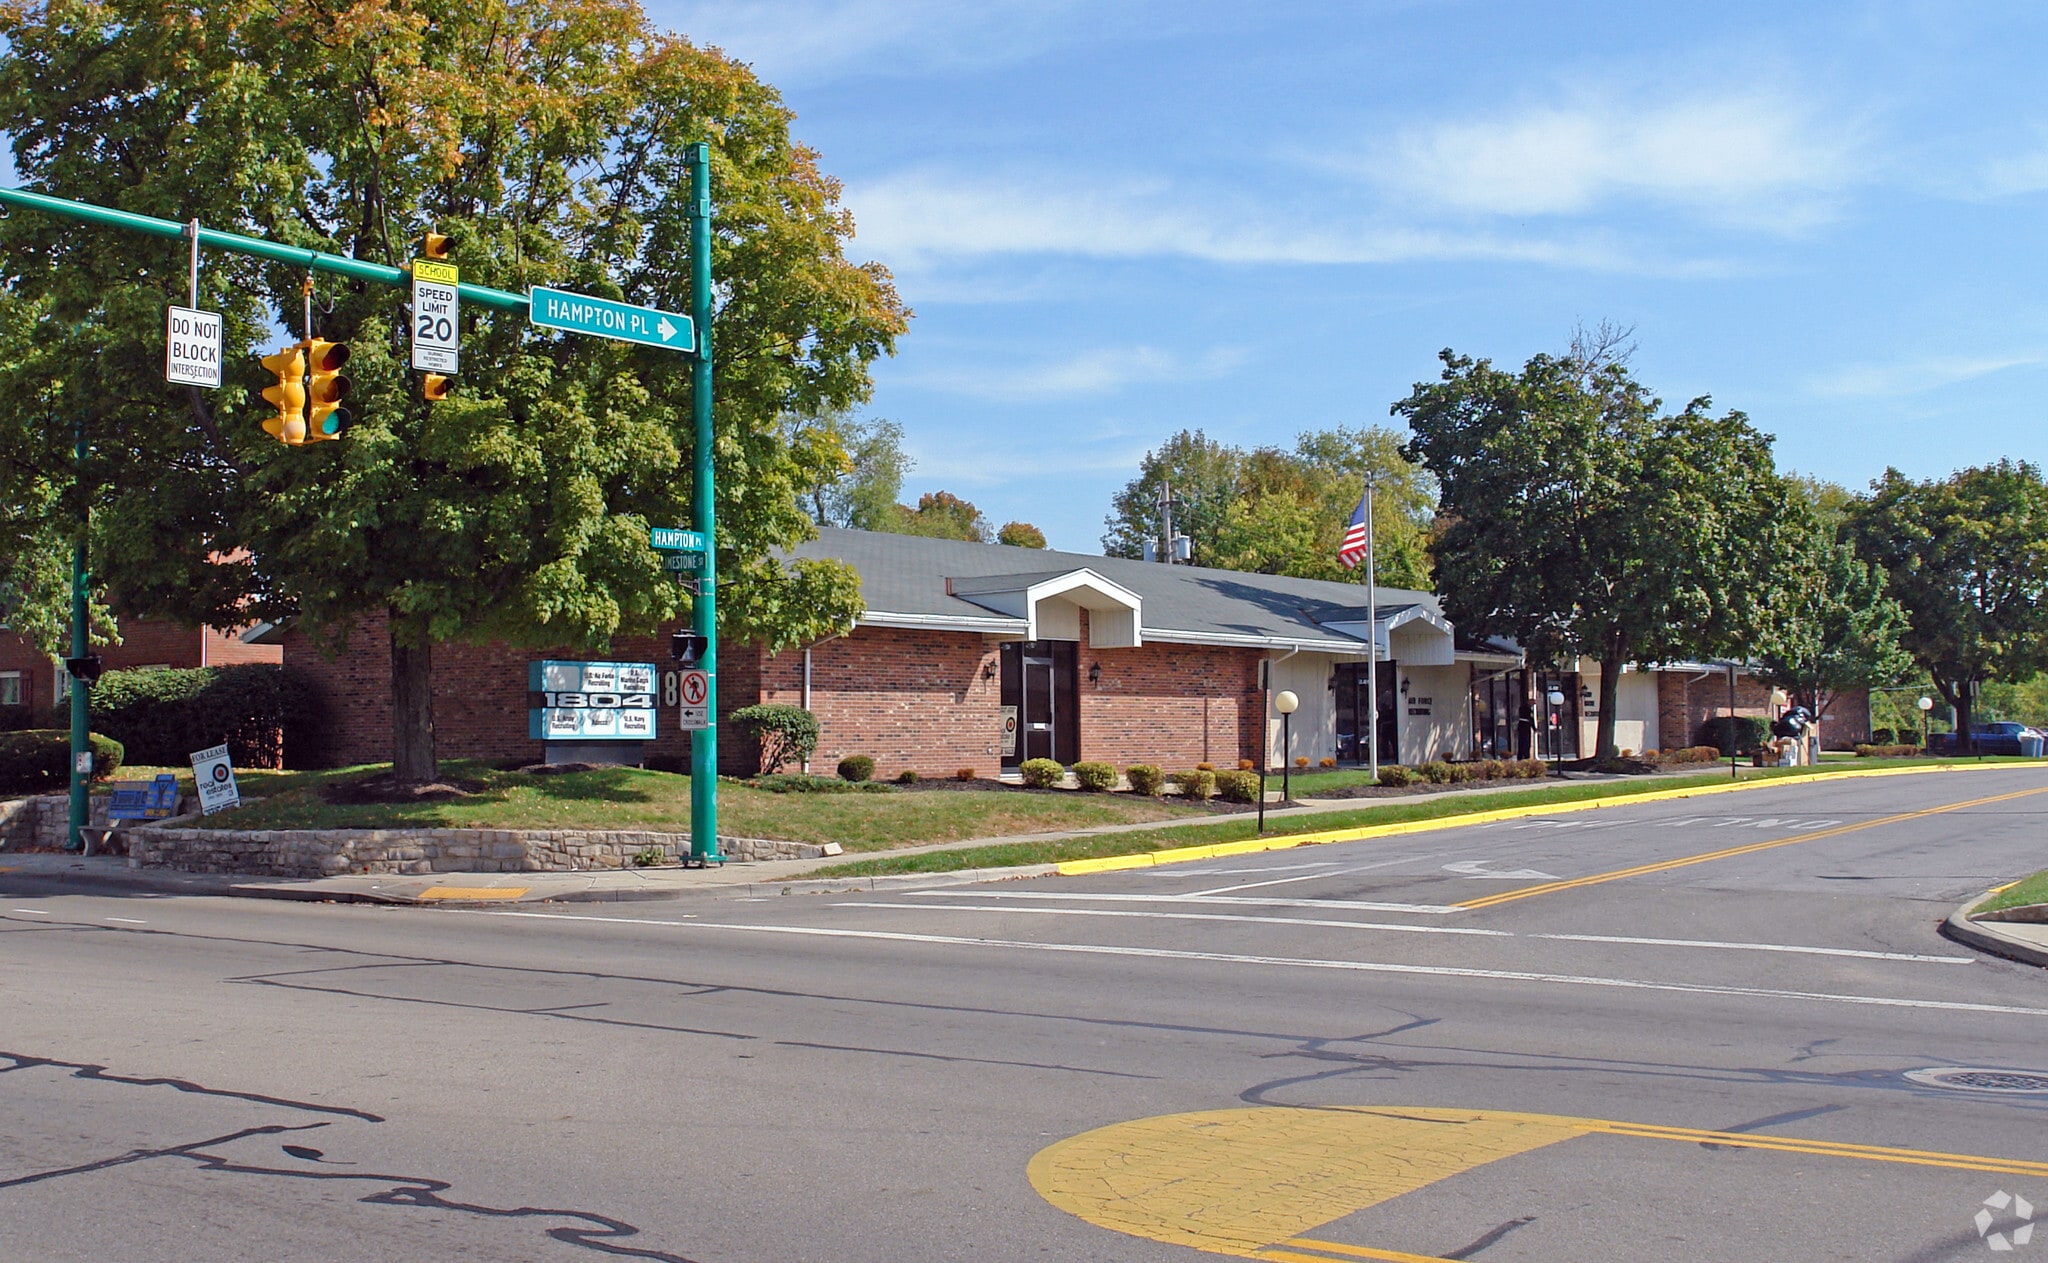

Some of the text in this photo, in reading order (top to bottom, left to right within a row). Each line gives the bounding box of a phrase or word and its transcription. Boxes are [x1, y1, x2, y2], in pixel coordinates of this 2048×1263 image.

[419, 265, 453, 280] SCHOOL
[418, 287, 453, 302] SPEED
[422, 301, 448, 315] LIMIT
[548, 298, 650, 335] HAMPTON PL
[173, 317, 218, 340] DO NOT
[417, 315, 453, 342] 20
[173, 342, 217, 363] BLOCK
[171, 362, 218, 379] INTERSECTION
[655, 530, 695, 548] HAMPTON
[588, 680, 611, 688] Recruiting
[623, 684, 646, 692] Recruiting
[545, 692, 652, 708] 1804
[551, 722, 576, 732] Recruiting
[624, 723, 647, 731] Recruiting
[191, 746, 227, 763] FOR LEASE
